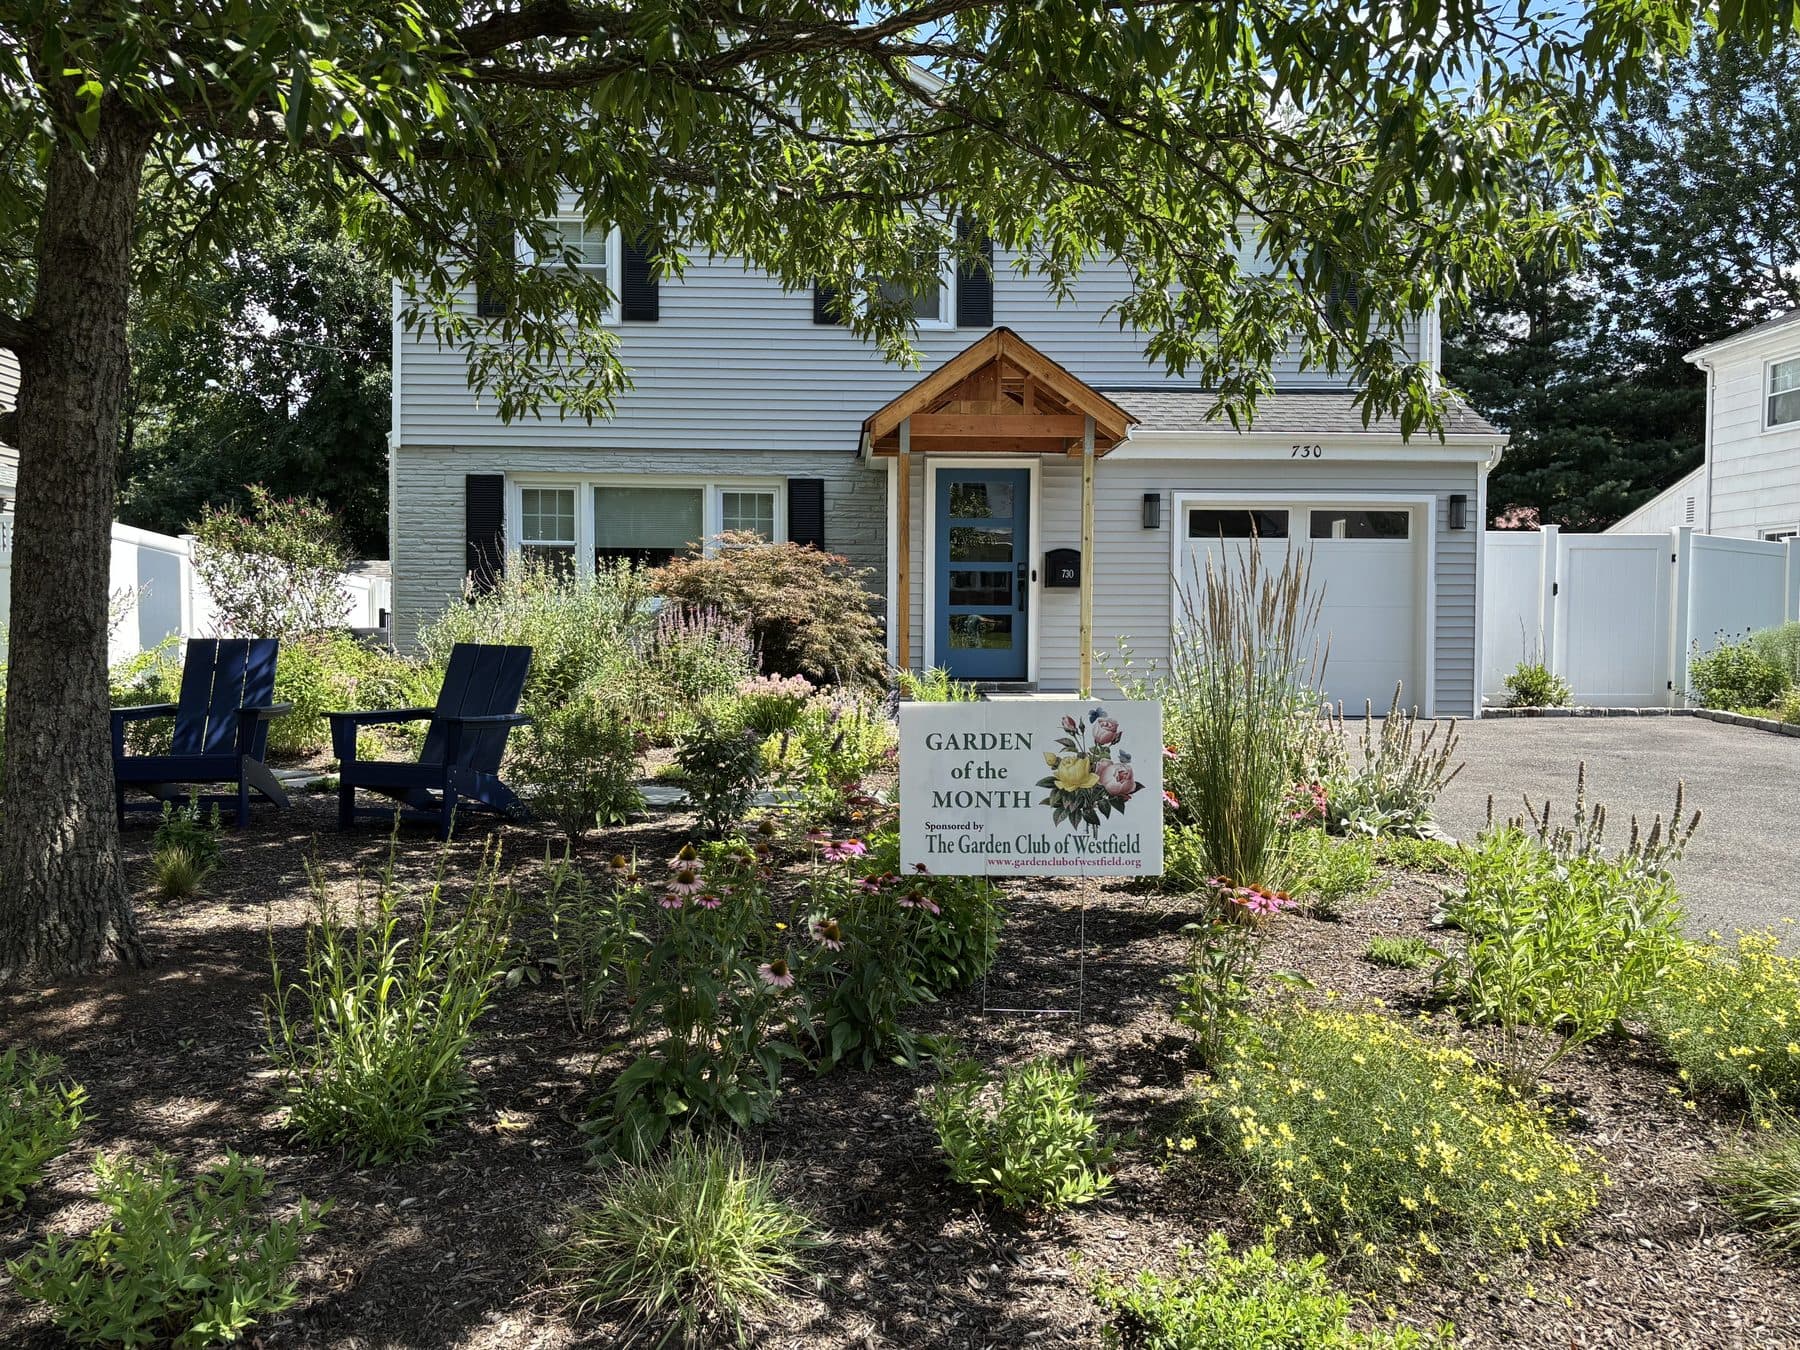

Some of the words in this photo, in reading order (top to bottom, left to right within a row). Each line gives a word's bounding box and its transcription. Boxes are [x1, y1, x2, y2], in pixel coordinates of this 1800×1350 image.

[1290, 445, 1322, 458] 730
[1061, 569, 1074, 579] 730
[925, 732, 1033, 751] GARDEN
[951, 761, 974, 779] of
[977, 762, 1008, 779] the
[931, 791, 1031, 809] MONTH
[925, 822, 972, 831] Sponsored
[973, 822, 984, 832] by
[925, 834, 957, 854] The
[958, 834, 1012, 854] Garden
[1015, 834, 1051, 854] Club
[1055, 834, 1072, 854] of
[1073, 834, 1140, 854] Westfield
[988, 856, 1142, 868] www.gardenclubofwestfield.org
